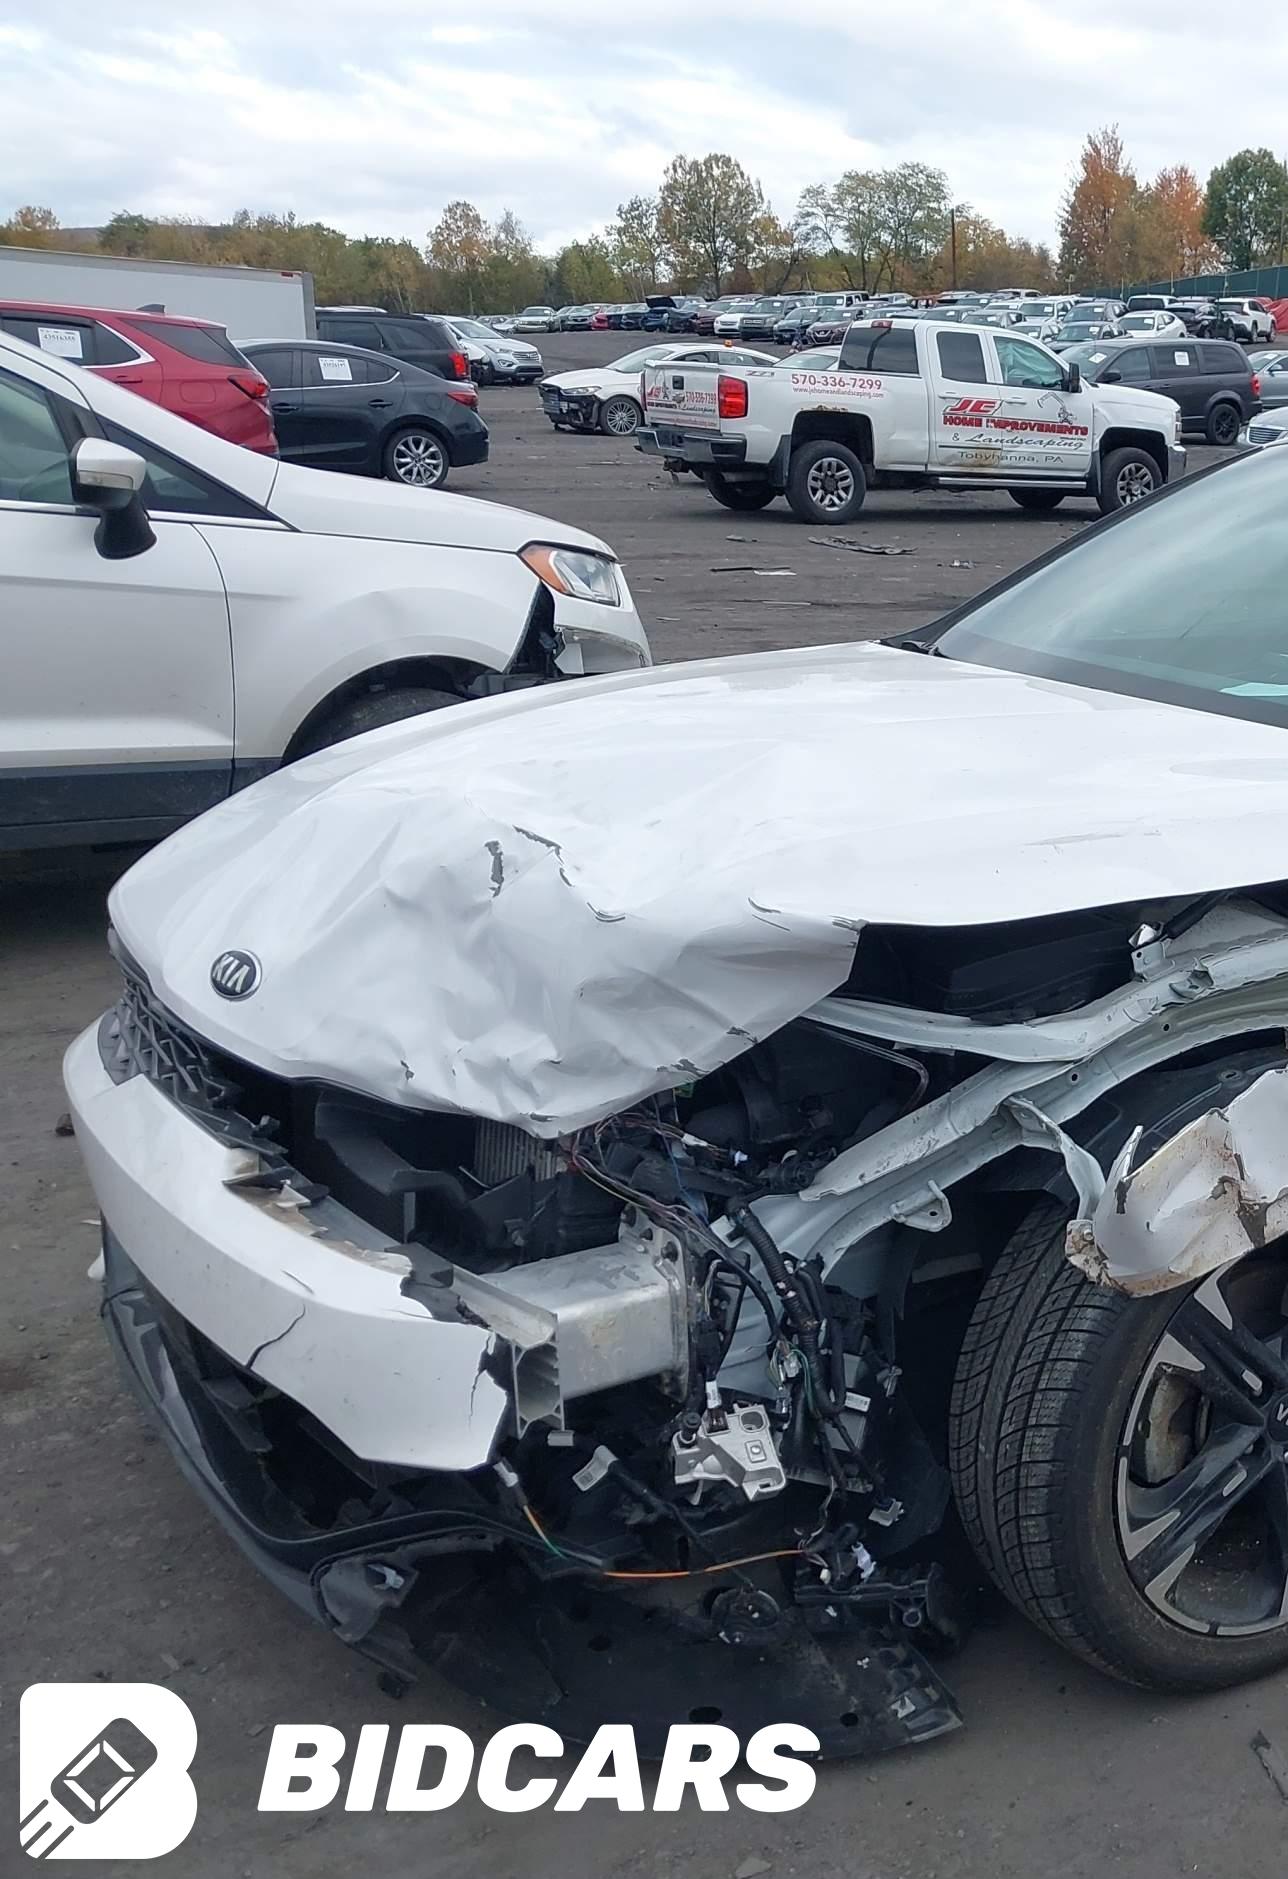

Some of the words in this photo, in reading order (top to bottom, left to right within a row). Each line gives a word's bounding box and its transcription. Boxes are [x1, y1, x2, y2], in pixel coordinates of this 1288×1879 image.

[791, 373, 882, 390] 570-336-7299
[948, 399, 997, 413] JE
[943, 415, 983, 428] HOME
[952, 433, 960, 442] &
[965, 433, 1084, 450] Landscaping
[959, 450, 1040, 463] Tobyhanna,
[1044, 455, 1064, 463] PA
